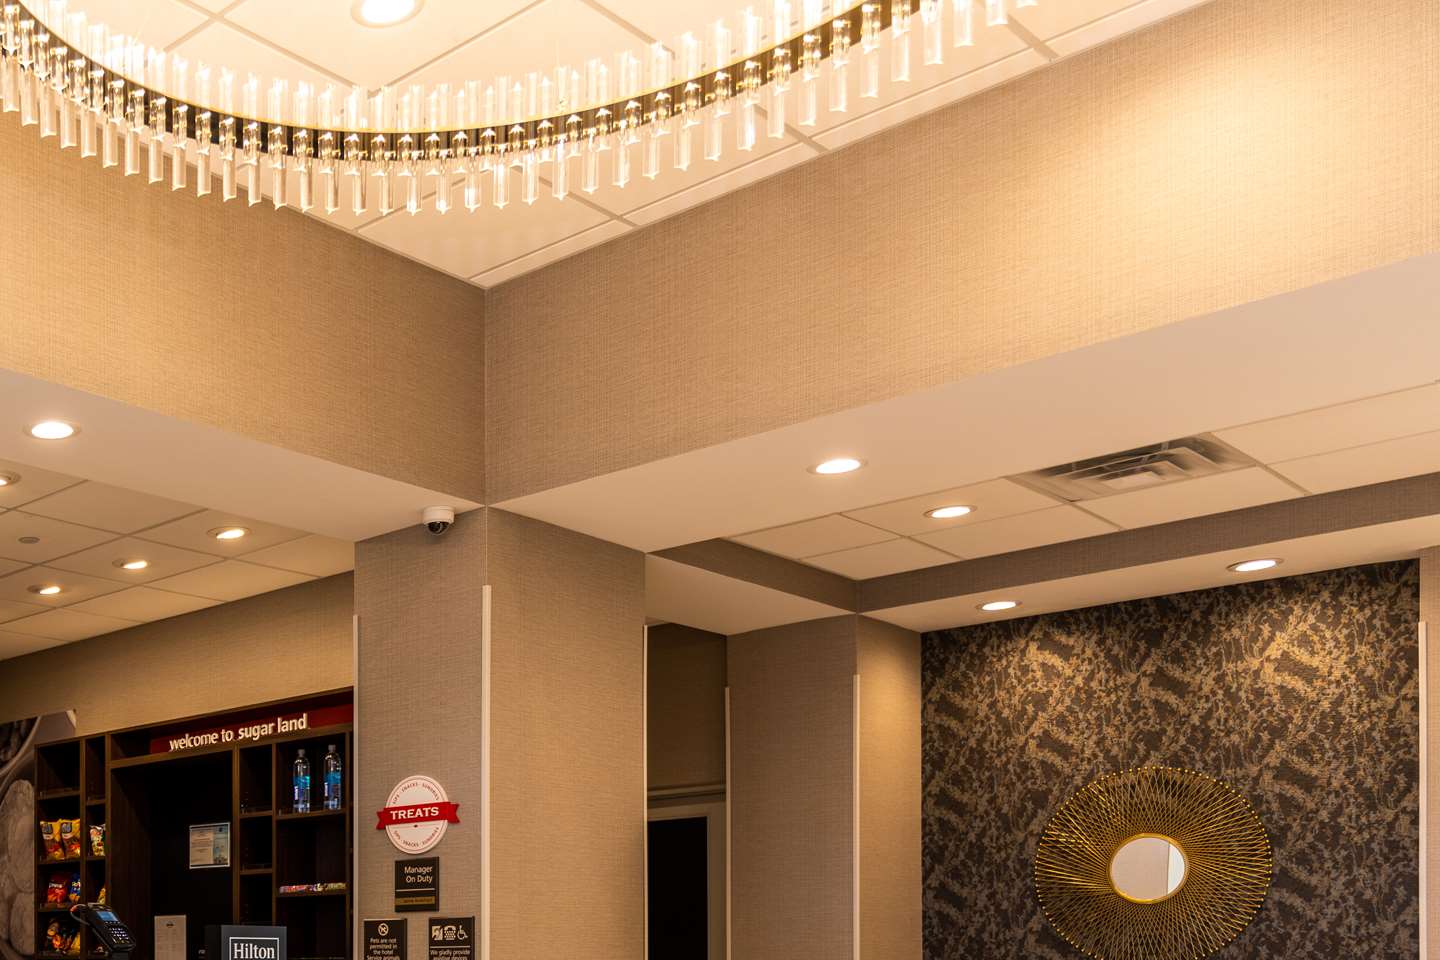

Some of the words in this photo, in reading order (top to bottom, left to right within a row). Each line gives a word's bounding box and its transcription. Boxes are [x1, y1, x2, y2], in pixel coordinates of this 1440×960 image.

[169, 732, 219, 752] welcome
[221, 729, 234, 742] to
[238, 722, 275, 741] sugar
[277, 713, 308, 733] land
[390, 807, 439, 820] TREATS
[404, 866, 433, 875] Manager
[406, 875, 416, 883] On
[417, 874, 433, 884] Duty
[233, 943, 275, 960] Hilton
[439, 949, 452, 957] gladly
[452, 949, 471, 957] provide
